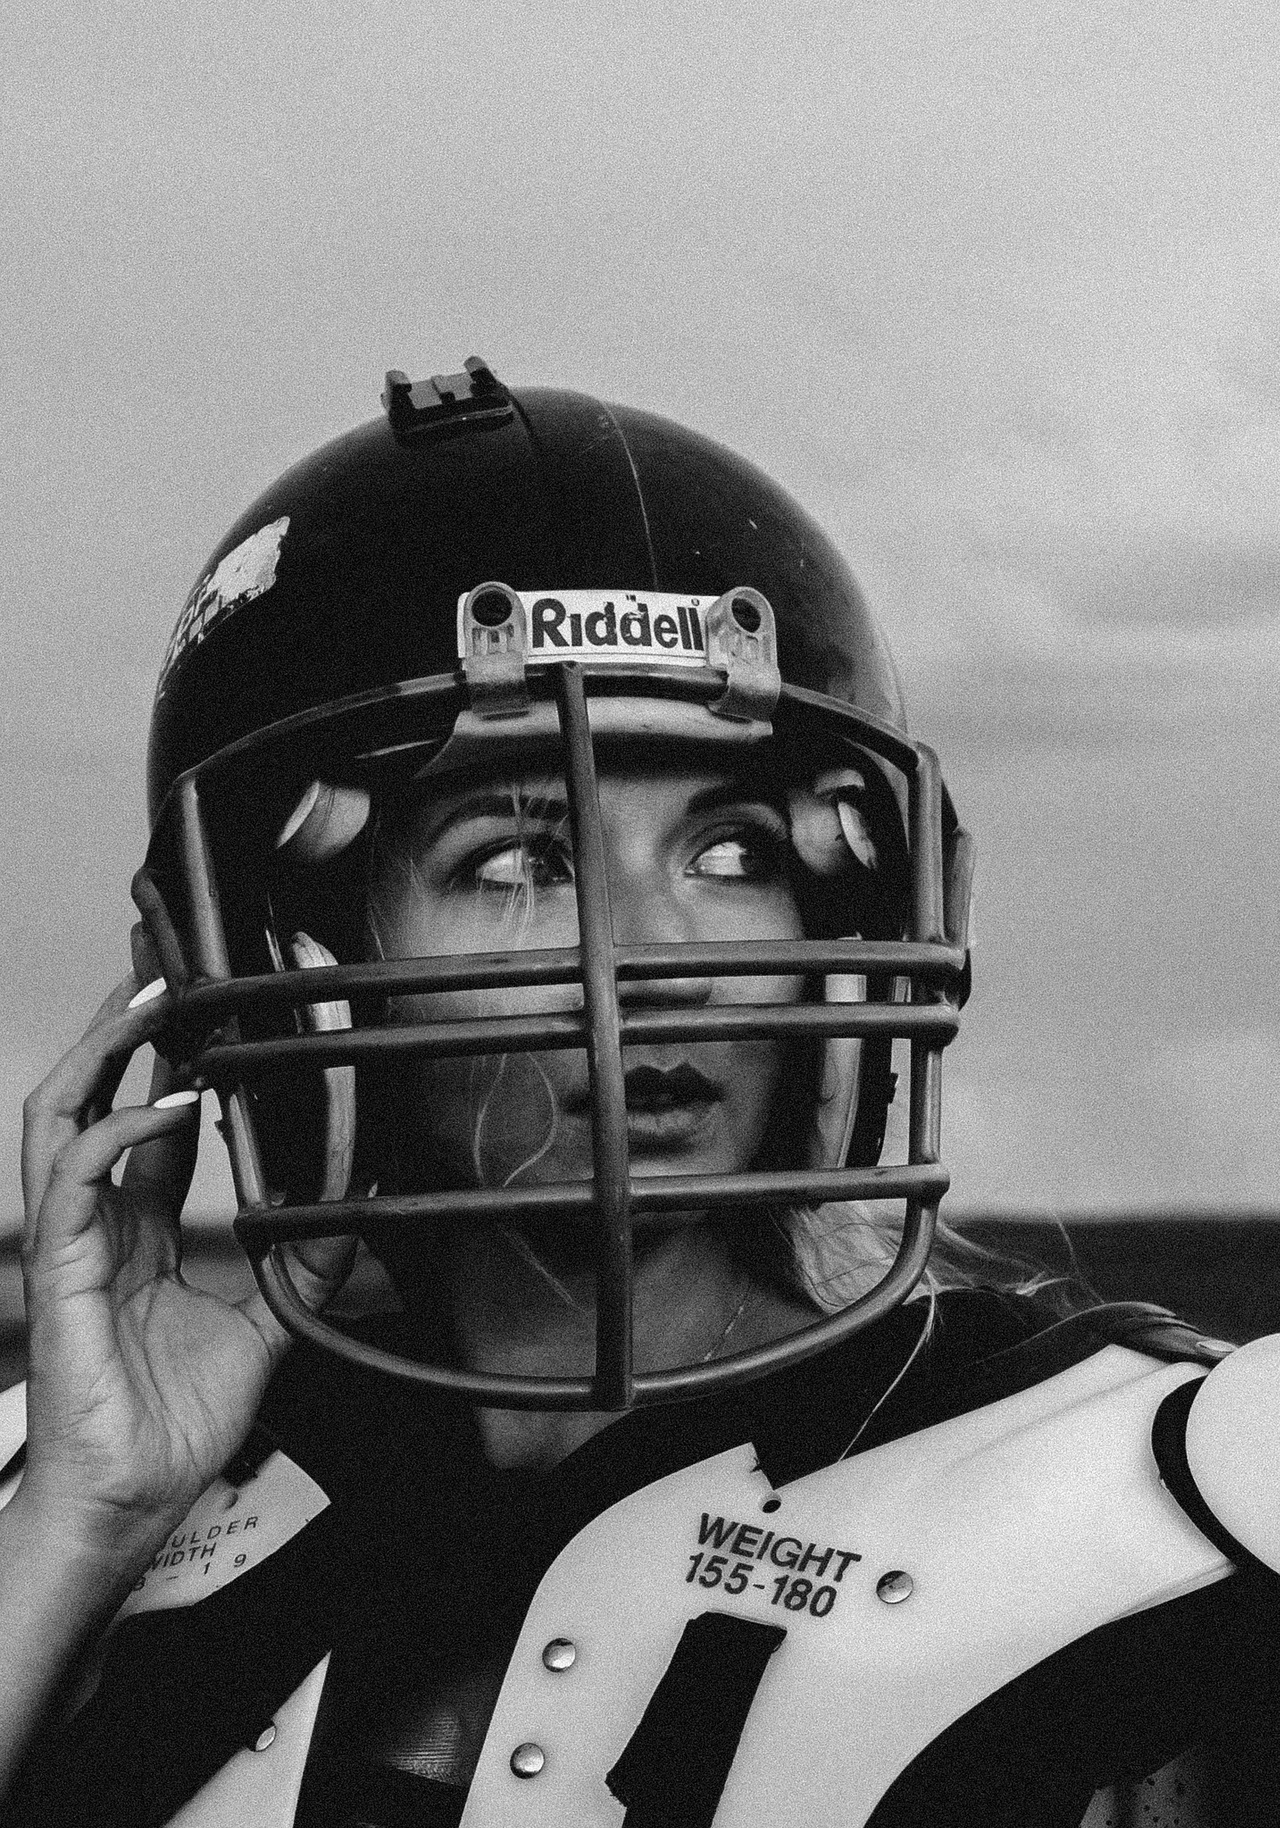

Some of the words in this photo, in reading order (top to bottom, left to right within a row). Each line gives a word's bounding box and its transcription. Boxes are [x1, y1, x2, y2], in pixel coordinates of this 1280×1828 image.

[531, 597, 705, 652] Riddell
[697, 1512, 862, 1583] WEIGHT
[685, 1552, 837, 1618] 155-180
